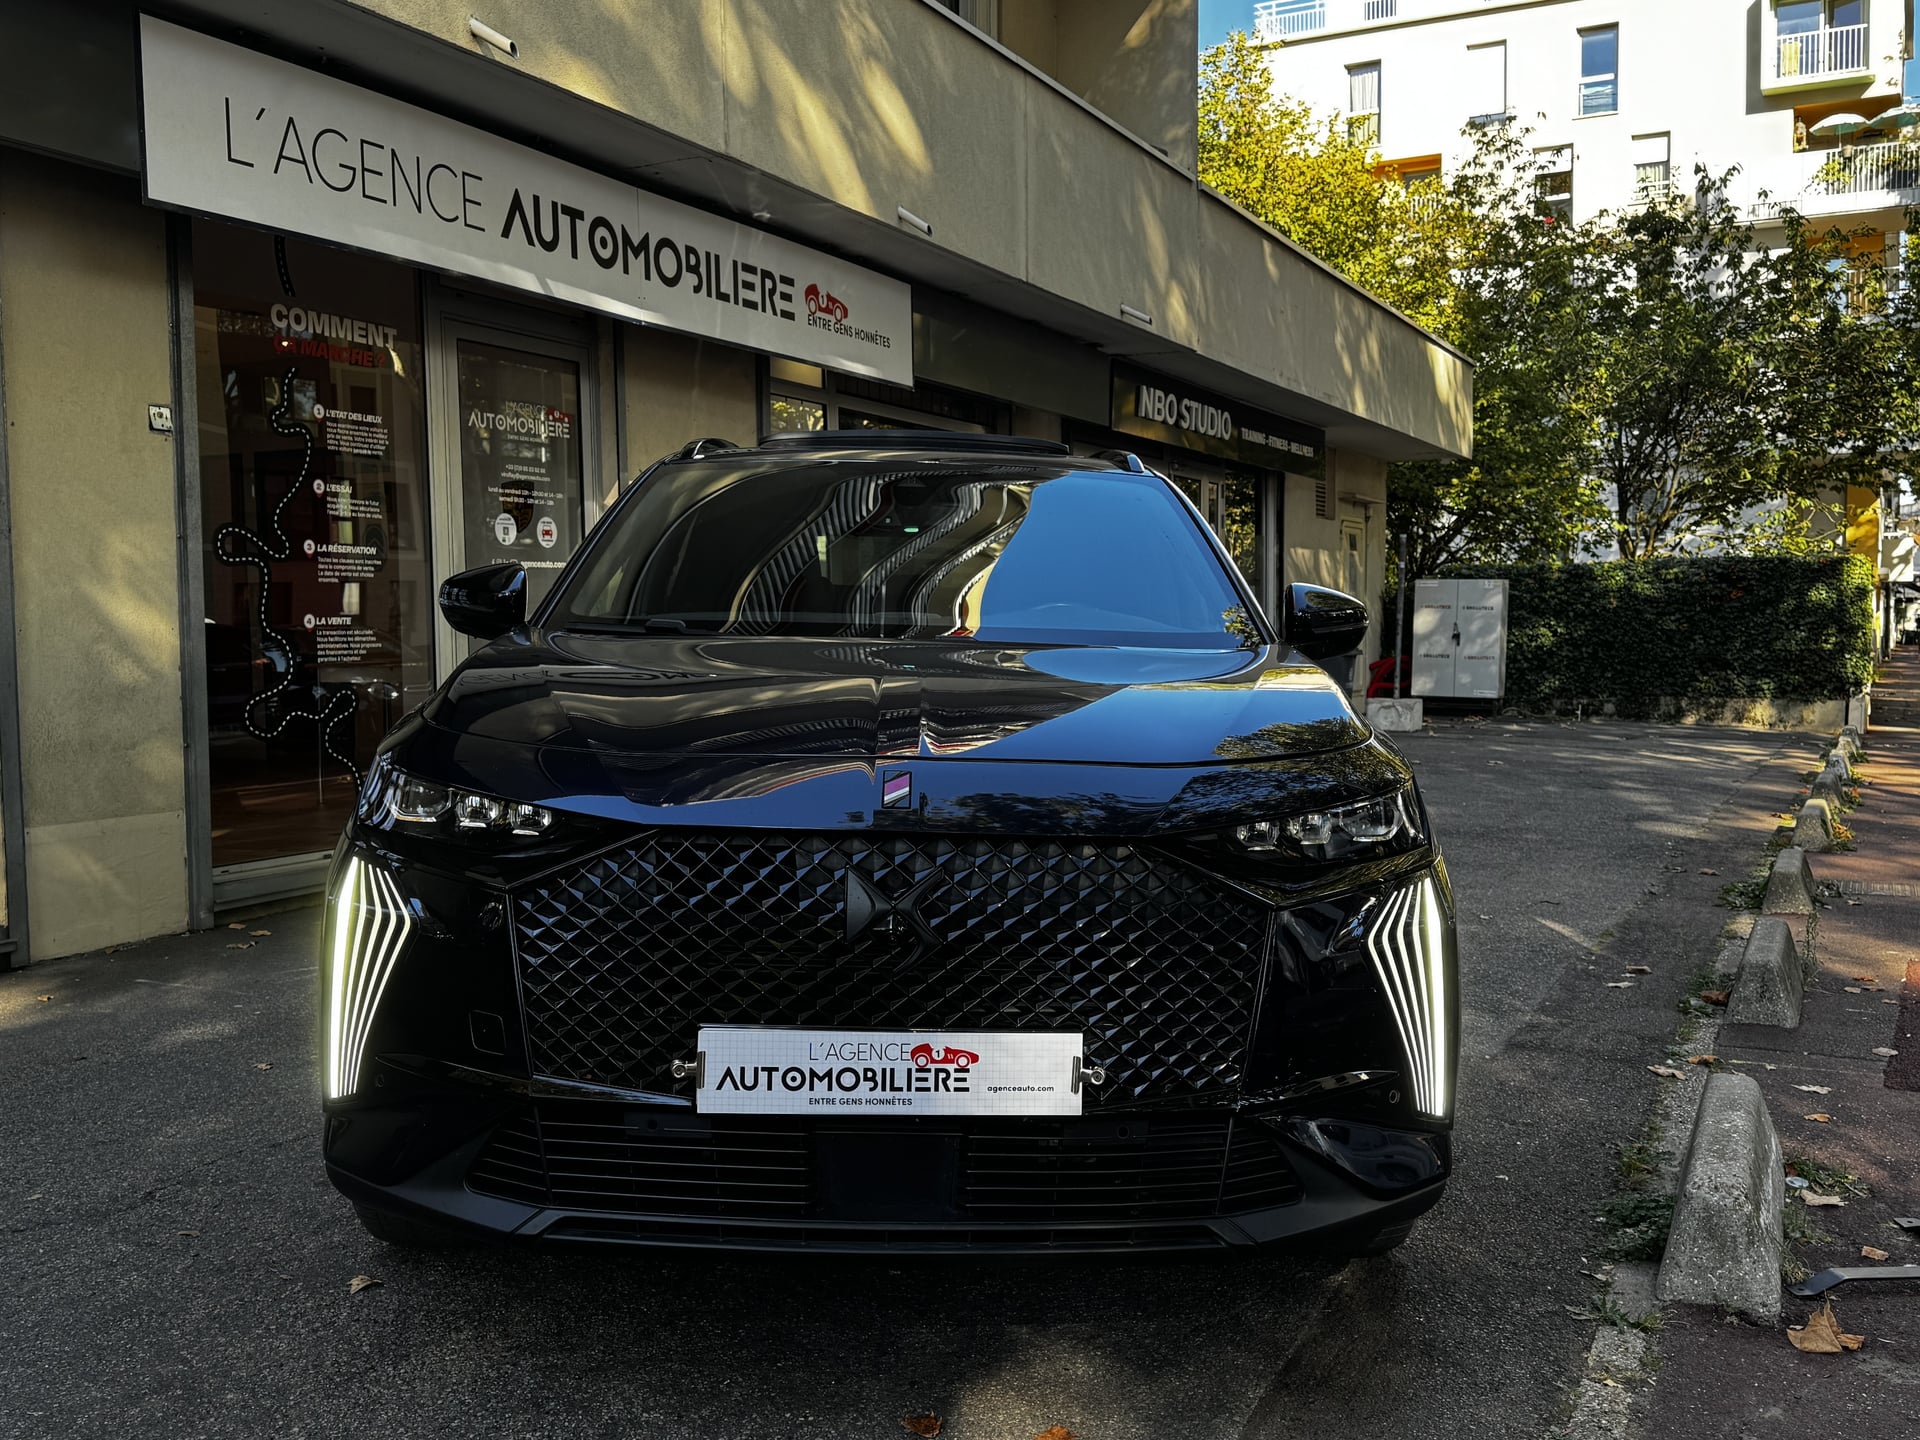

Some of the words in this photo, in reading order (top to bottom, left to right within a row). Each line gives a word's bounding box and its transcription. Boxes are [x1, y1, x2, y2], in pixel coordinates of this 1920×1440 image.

[224, 97, 485, 232] L'AGENCE
[500, 188, 796, 322] AUTOMOBILIERE
[271, 303, 397, 350] COMMENT
[808, 314, 831, 331] ENTRE
[834, 322, 853, 338] GENS
[855, 328, 890, 348] HONNÊTES
[301, 341, 374, 367] MARCHE
[348, 412, 362, 421] DES
[363, 414, 382, 424] LIEUX
[1138, 384, 1178, 425] NBO
[1180, 398, 1232, 440] STUDIO
[317, 544, 327, 552] LA
[328, 543, 376, 555] RÉSERVATION
[327, 617, 352, 625] VENTE
[808, 1042, 911, 1062] L'AGENCE
[716, 1066, 970, 1092] AUTOMOBILIERE
[987, 1085, 1054, 1094] agenceauto.com
[808, 1097, 837, 1106] ENTRE
[838, 1097, 863, 1106] GENS
[865, 1095, 913, 1106] HONNÊTES
